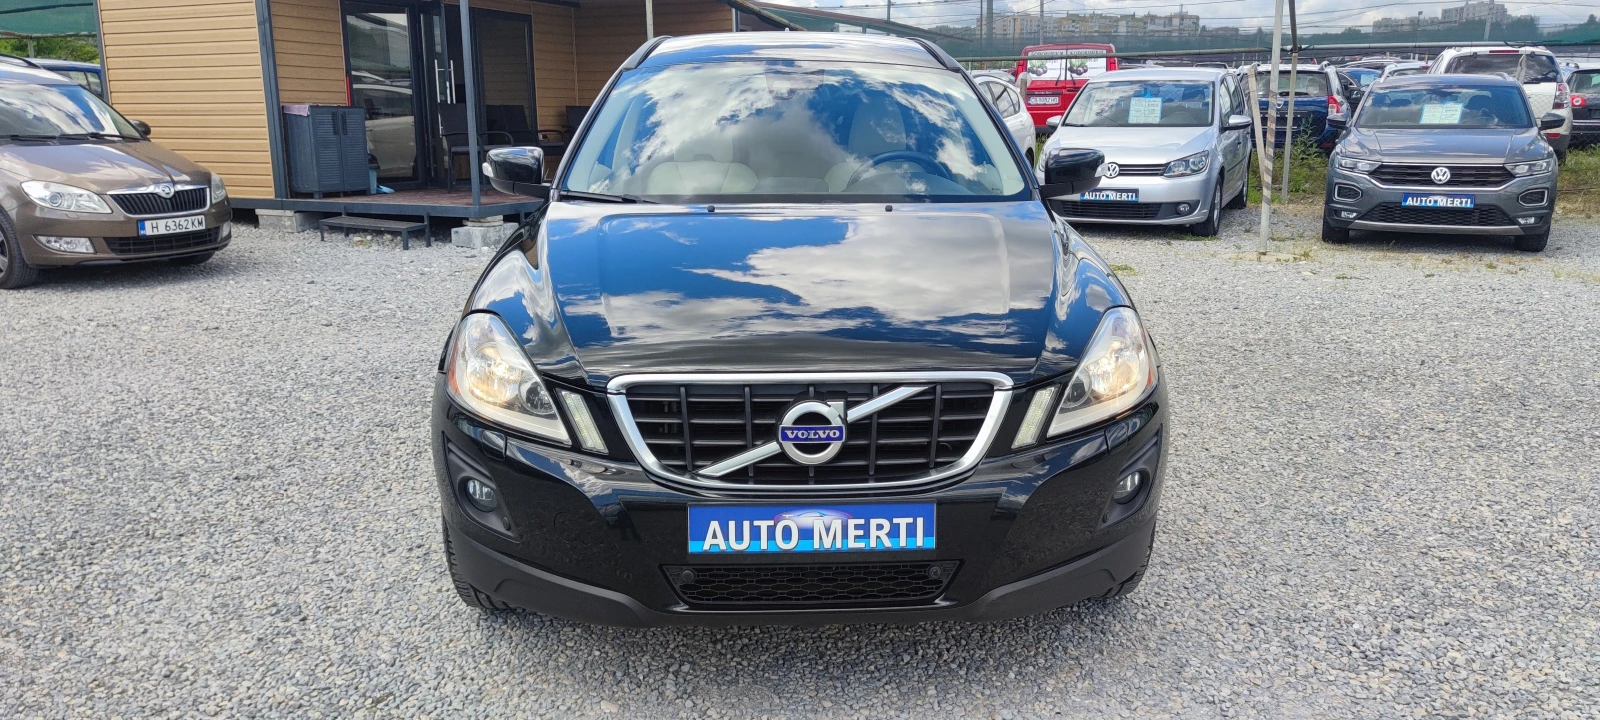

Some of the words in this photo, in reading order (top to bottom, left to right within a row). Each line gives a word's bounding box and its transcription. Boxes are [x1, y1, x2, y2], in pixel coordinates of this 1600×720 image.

[1084, 192, 1106, 200] AUTO
[1108, 192, 1136, 201] MERTI
[1406, 196, 1434, 206] AUTO
[1437, 198, 1471, 207] MERTI
[151, 221, 159, 233] H
[784, 428, 840, 439] VOLVO
[703, 519, 799, 551] AUTO
[813, 516, 924, 549] MERTI
